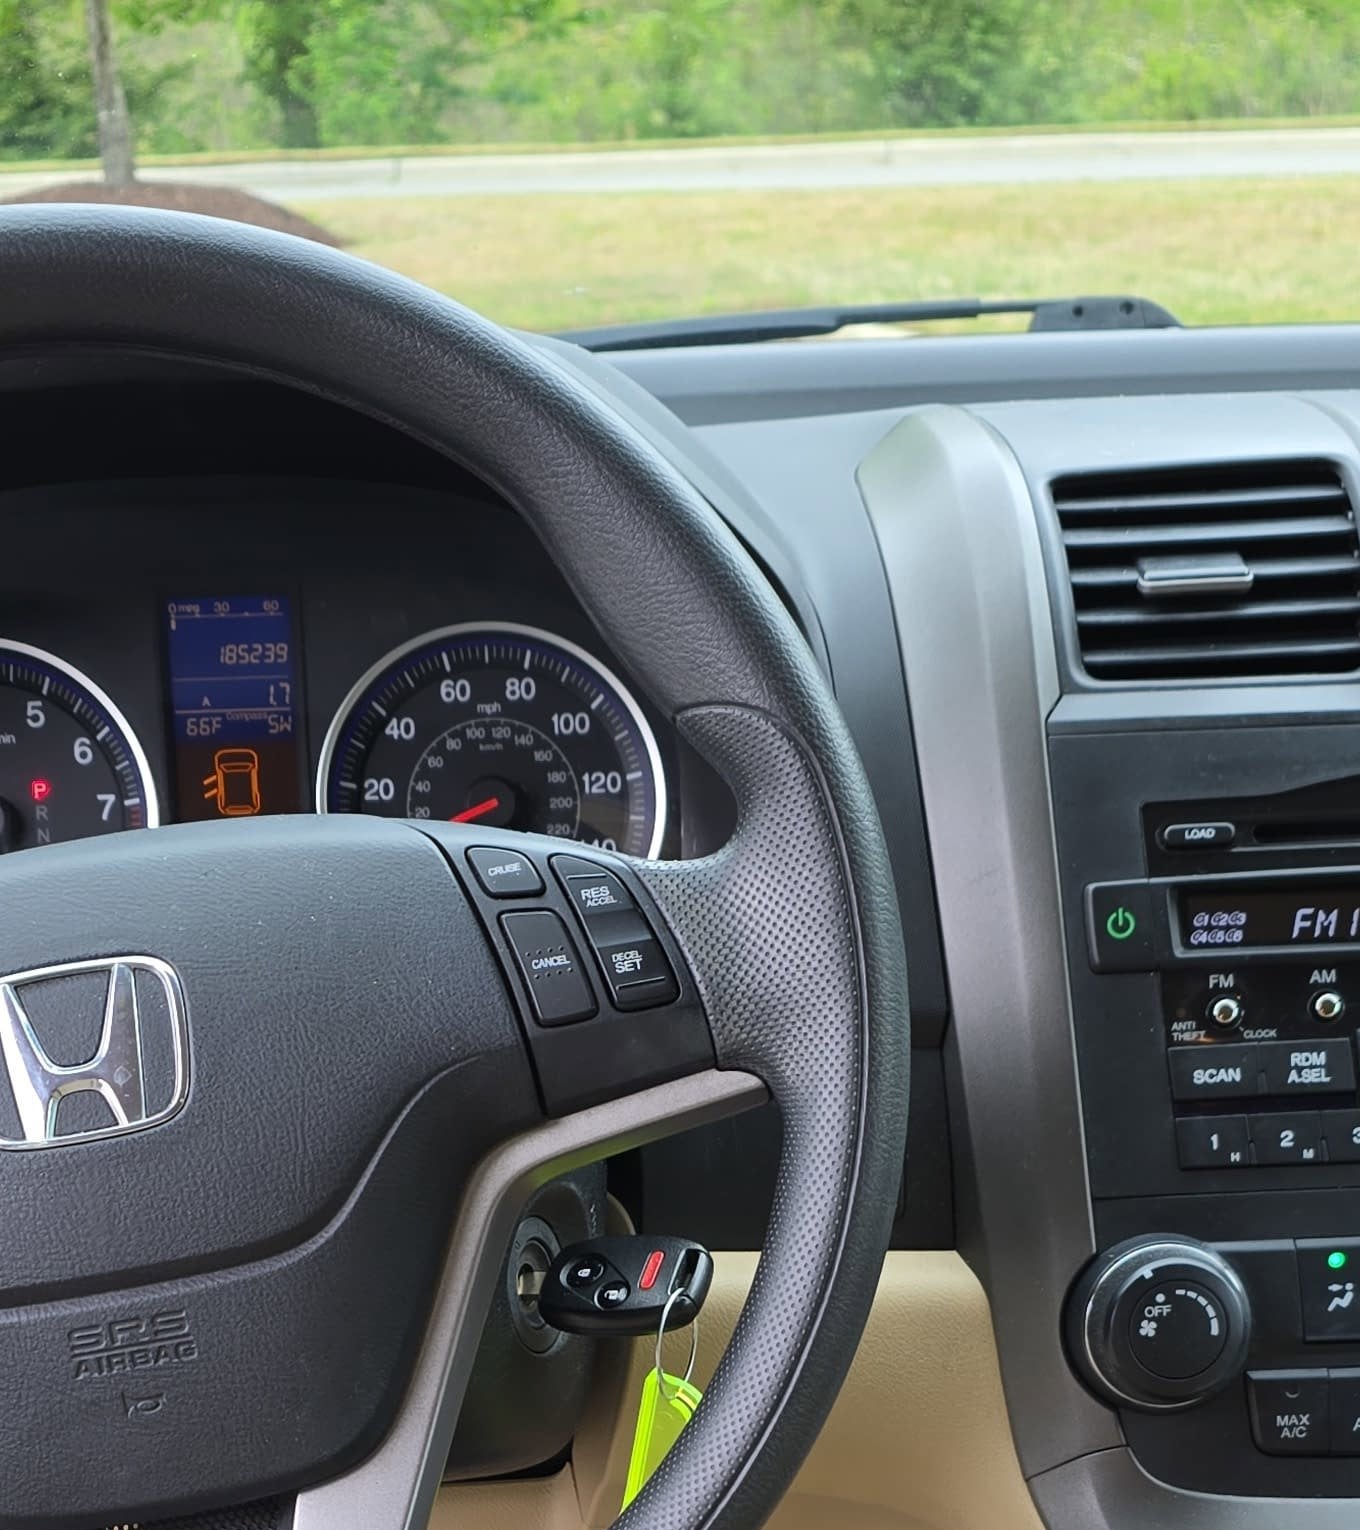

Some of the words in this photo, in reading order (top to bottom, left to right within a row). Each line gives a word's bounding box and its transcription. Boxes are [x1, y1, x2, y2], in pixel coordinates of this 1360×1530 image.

[214, 601, 230, 613] 30
[220, 643, 289, 664] 185239
[440, 679, 471, 702] 60
[505, 677, 536, 701] 80
[26, 701, 45, 728] 5
[477, 702, 501, 715] mph
[385, 717, 415, 740] 40
[552, 712, 590, 735] 100
[466, 727, 485, 739] 100
[491, 726, 511, 738] 120
[446, 738, 461, 750] 80
[514, 734, 534, 746] 140
[73, 737, 93, 765] 6
[428, 756, 444, 769] 60
[547, 771, 567, 783] 180
[582, 772, 622, 794] 120
[31, 781, 48, 799] P
[364, 778, 394, 800] 20
[415, 780, 431, 793] 40
[97, 794, 116, 821] 7
[549, 797, 573, 809] 200
[35, 805, 48, 821] R
[415, 806, 431, 819] 20
[547, 824, 570, 836] 220
[1184, 827, 1216, 840] LOAD
[488, 862, 521, 877] CRUISE
[581, 886, 610, 900] RES
[586, 896, 617, 908] ACCEL
[532, 954, 570, 970] CANCEL
[612, 950, 642, 963] DECEL
[615, 959, 642, 974] SET
[1209, 974, 1234, 989] FM
[1309, 969, 1336, 984] AM
[1171, 1021, 1196, 1032] ANTI
[1172, 1031, 1206, 1042] THEFT
[1243, 1028, 1277, 1039] CLOCK
[1291, 1051, 1326, 1067] RDM
[1193, 1068, 1241, 1084] SCAN
[1210, 1133, 1219, 1150] 1
[1280, 1130, 1295, 1147] 2
[1230, 1152, 1240, 1163] H
[1303, 1148, 1315, 1159] M
[1145, 1305, 1172, 1318] OFF
[72, 1342, 198, 1380] AIRBAG
[1276, 1414, 1309, 1427] MAX
[1281, 1426, 1307, 1438] A/C
